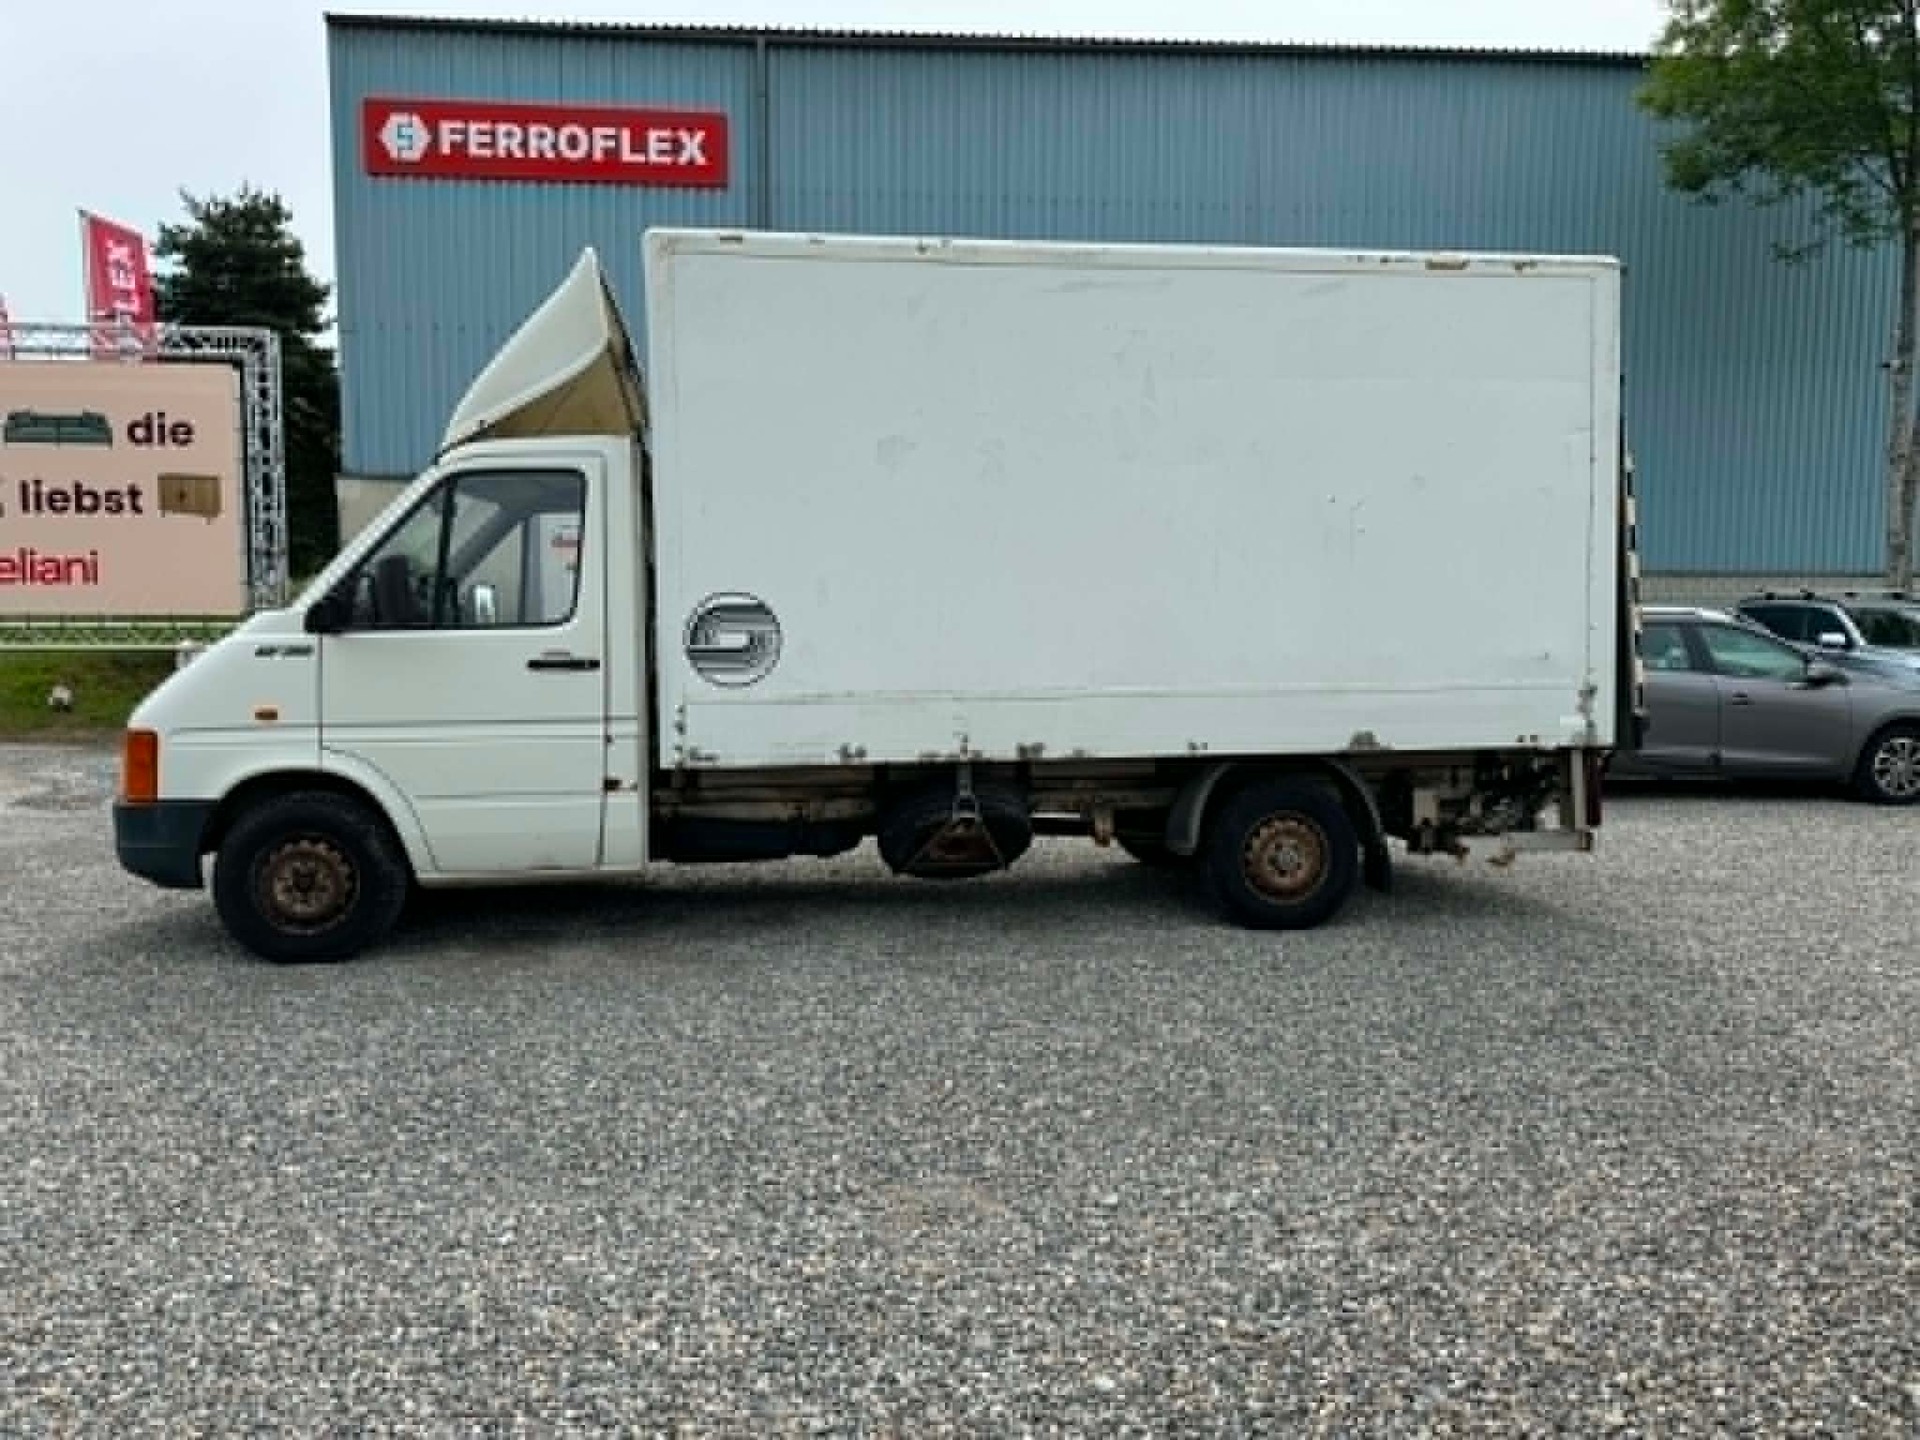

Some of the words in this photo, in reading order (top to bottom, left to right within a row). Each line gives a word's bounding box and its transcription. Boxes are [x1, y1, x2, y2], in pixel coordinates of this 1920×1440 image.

[437, 119, 706, 166] FERROFLEX
[127, 411, 195, 446] die
[20, 479, 143, 515] liebst
